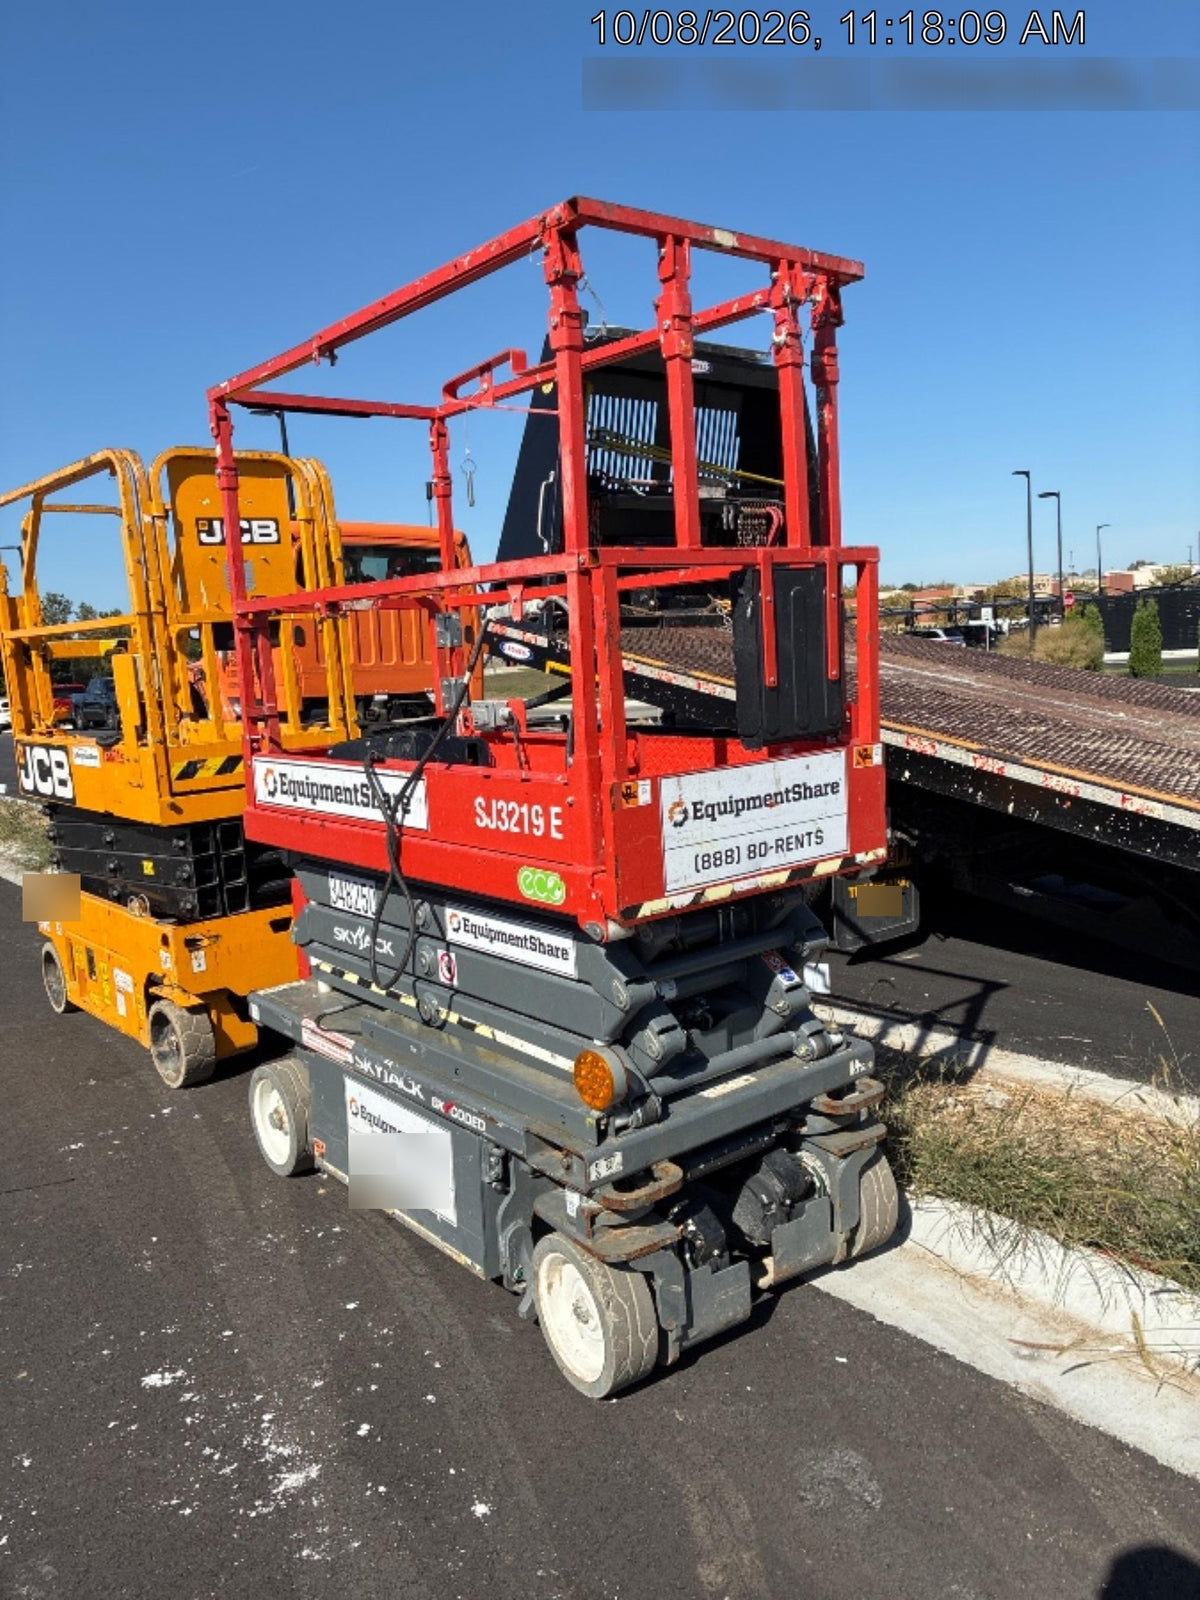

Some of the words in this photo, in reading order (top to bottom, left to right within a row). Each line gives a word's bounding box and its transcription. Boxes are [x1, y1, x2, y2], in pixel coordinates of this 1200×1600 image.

[20, 746, 73, 798] JCB
[474, 796, 545, 837] SJ3219
[551, 806, 564, 840] E
[692, 781, 840, 822] EquipmentShare
[695, 848, 741, 874] (888)
[747, 829, 824, 861] 80-RENTS
[333, 925, 395, 957] SKYJACK
[462, 917, 570, 961] EquipmentShare
[355, 1055, 425, 1100] SKYJACK
